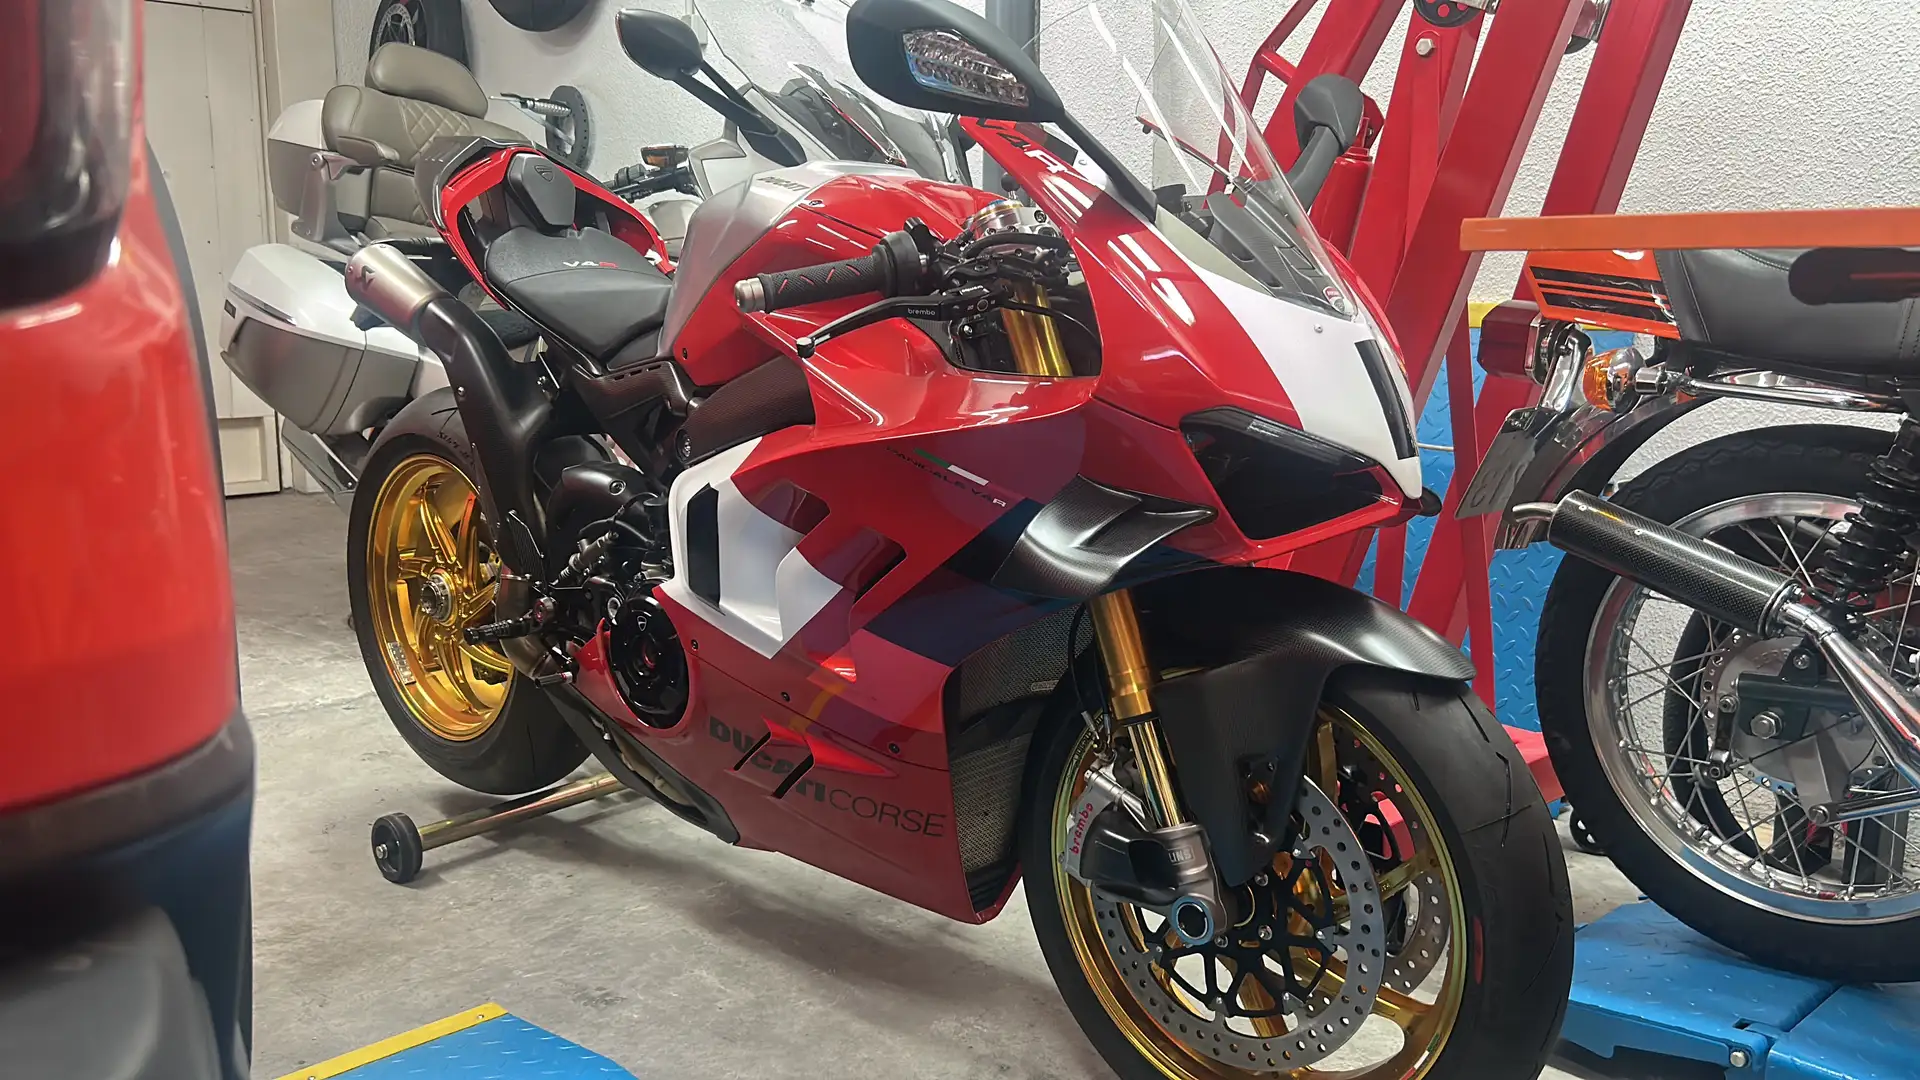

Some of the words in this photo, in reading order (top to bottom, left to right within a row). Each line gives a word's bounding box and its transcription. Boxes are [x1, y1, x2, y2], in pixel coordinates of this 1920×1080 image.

[907, 307, 936, 316] brembo
[828, 788, 948, 838] CORSE
[1070, 803, 1094, 855] brembo
